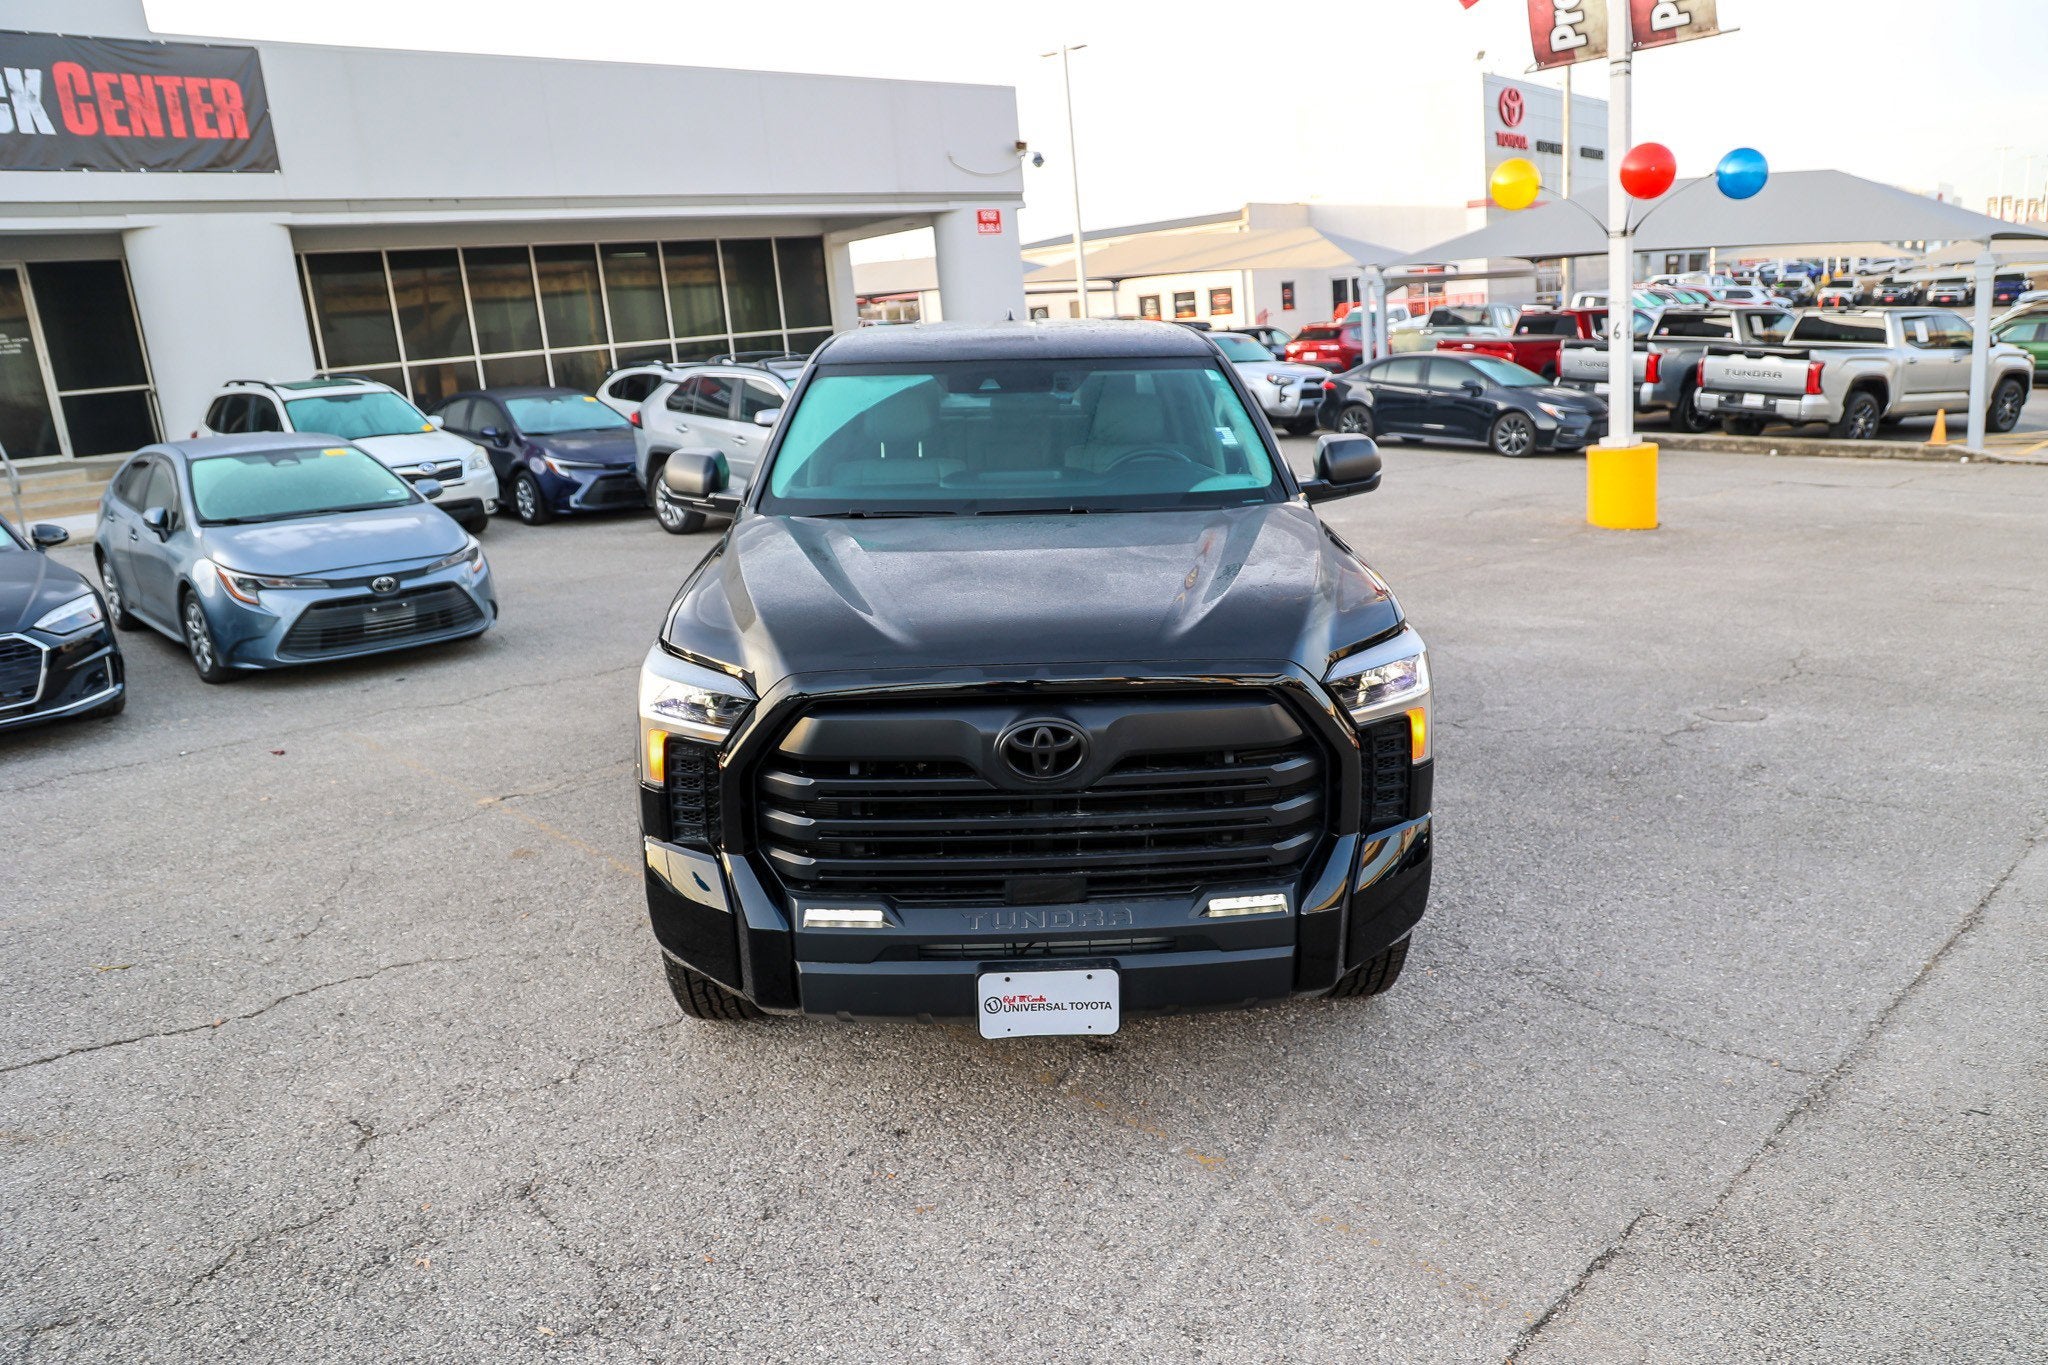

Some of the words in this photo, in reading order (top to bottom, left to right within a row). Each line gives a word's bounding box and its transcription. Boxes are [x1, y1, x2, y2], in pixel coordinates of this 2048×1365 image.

[1650, 0, 1692, 32] P
[52, 61, 249, 139] CENTER
[1577, 359, 1609, 369] TUND
[1723, 368, 1783, 379] TUNDRA
[961, 907, 1133, 930] TUNDRA
[1003, 1001, 1068, 1013] UNIVERSAL
[1069, 1001, 1113, 1011] TOYOTA
